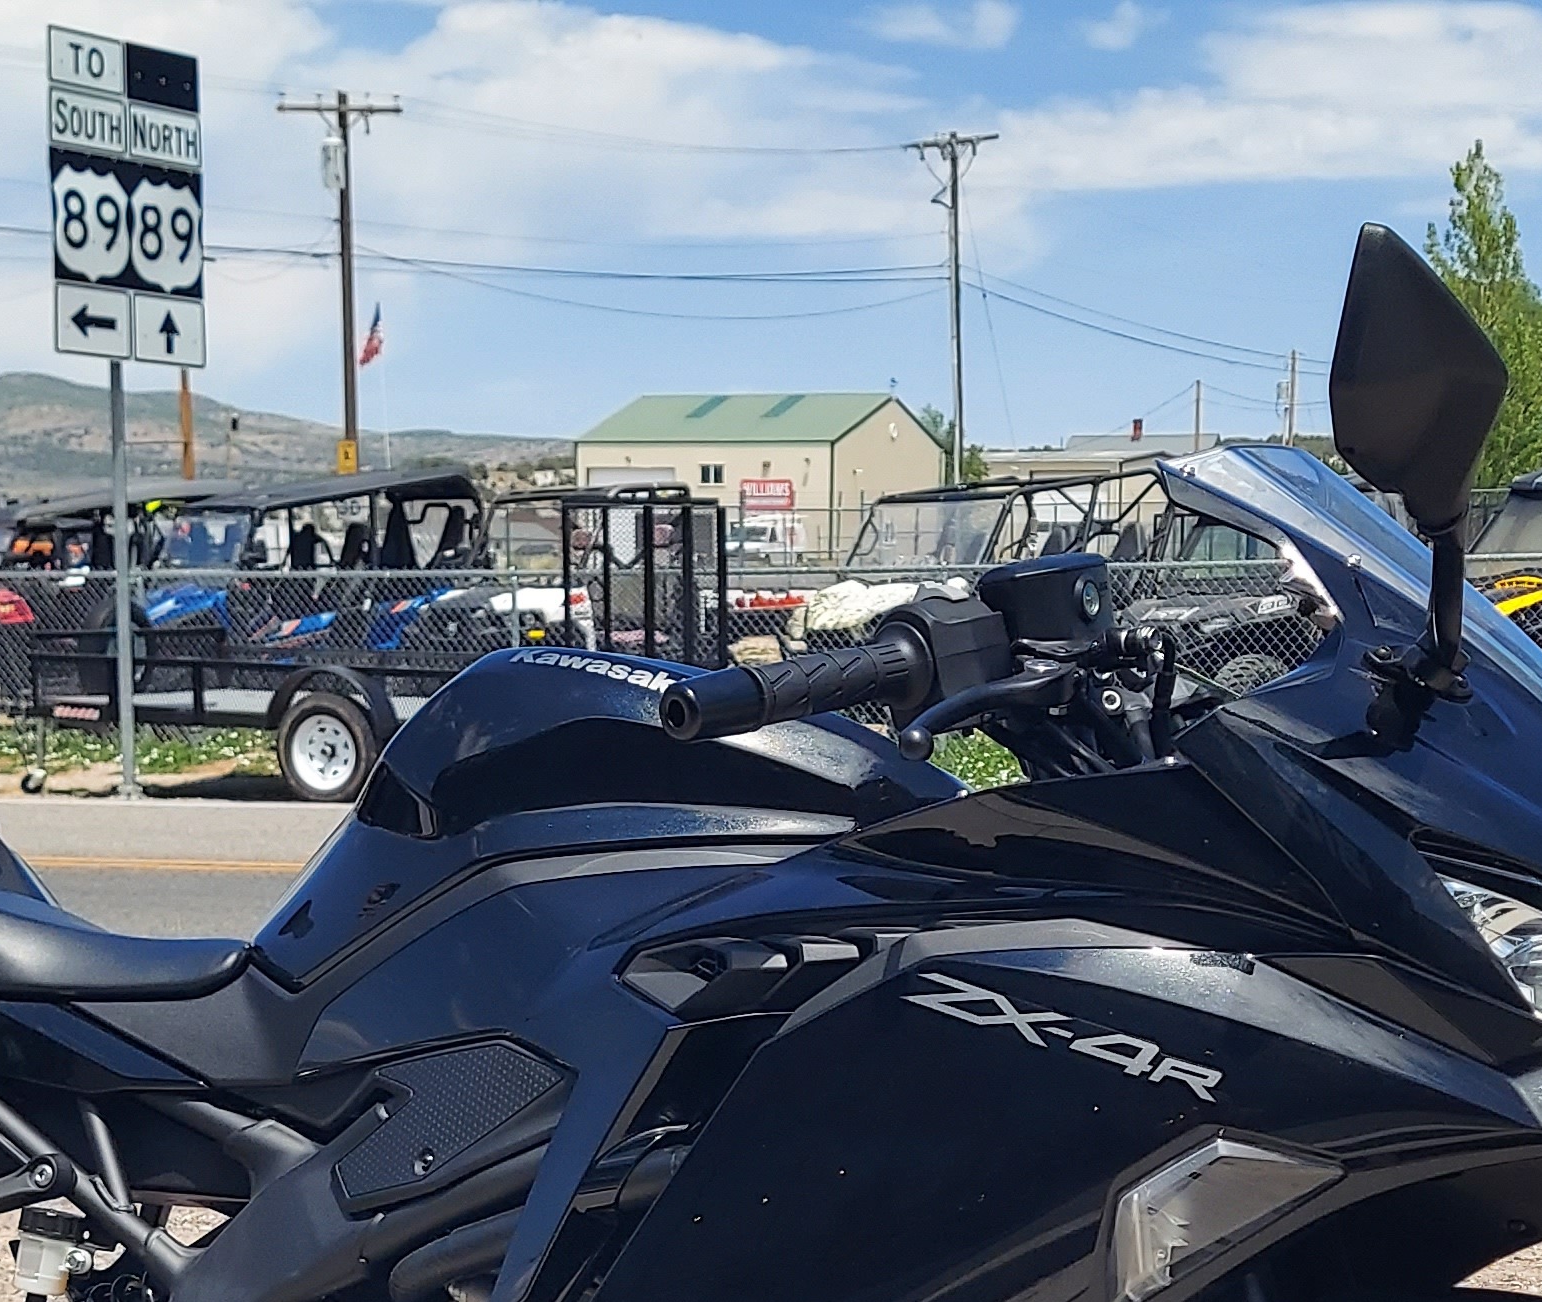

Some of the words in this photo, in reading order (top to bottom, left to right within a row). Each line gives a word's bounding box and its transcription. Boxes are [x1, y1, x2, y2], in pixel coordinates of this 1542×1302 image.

[69, 42, 104, 77] TO
[55, 99, 122, 145] SOUTH
[132, 112, 198, 160] NORTH
[63, 190, 119, 252] 89
[140, 205, 194, 263] 89
[510, 649, 685, 694] Kawasak
[900, 971, 1225, 1103] ZX-4R
